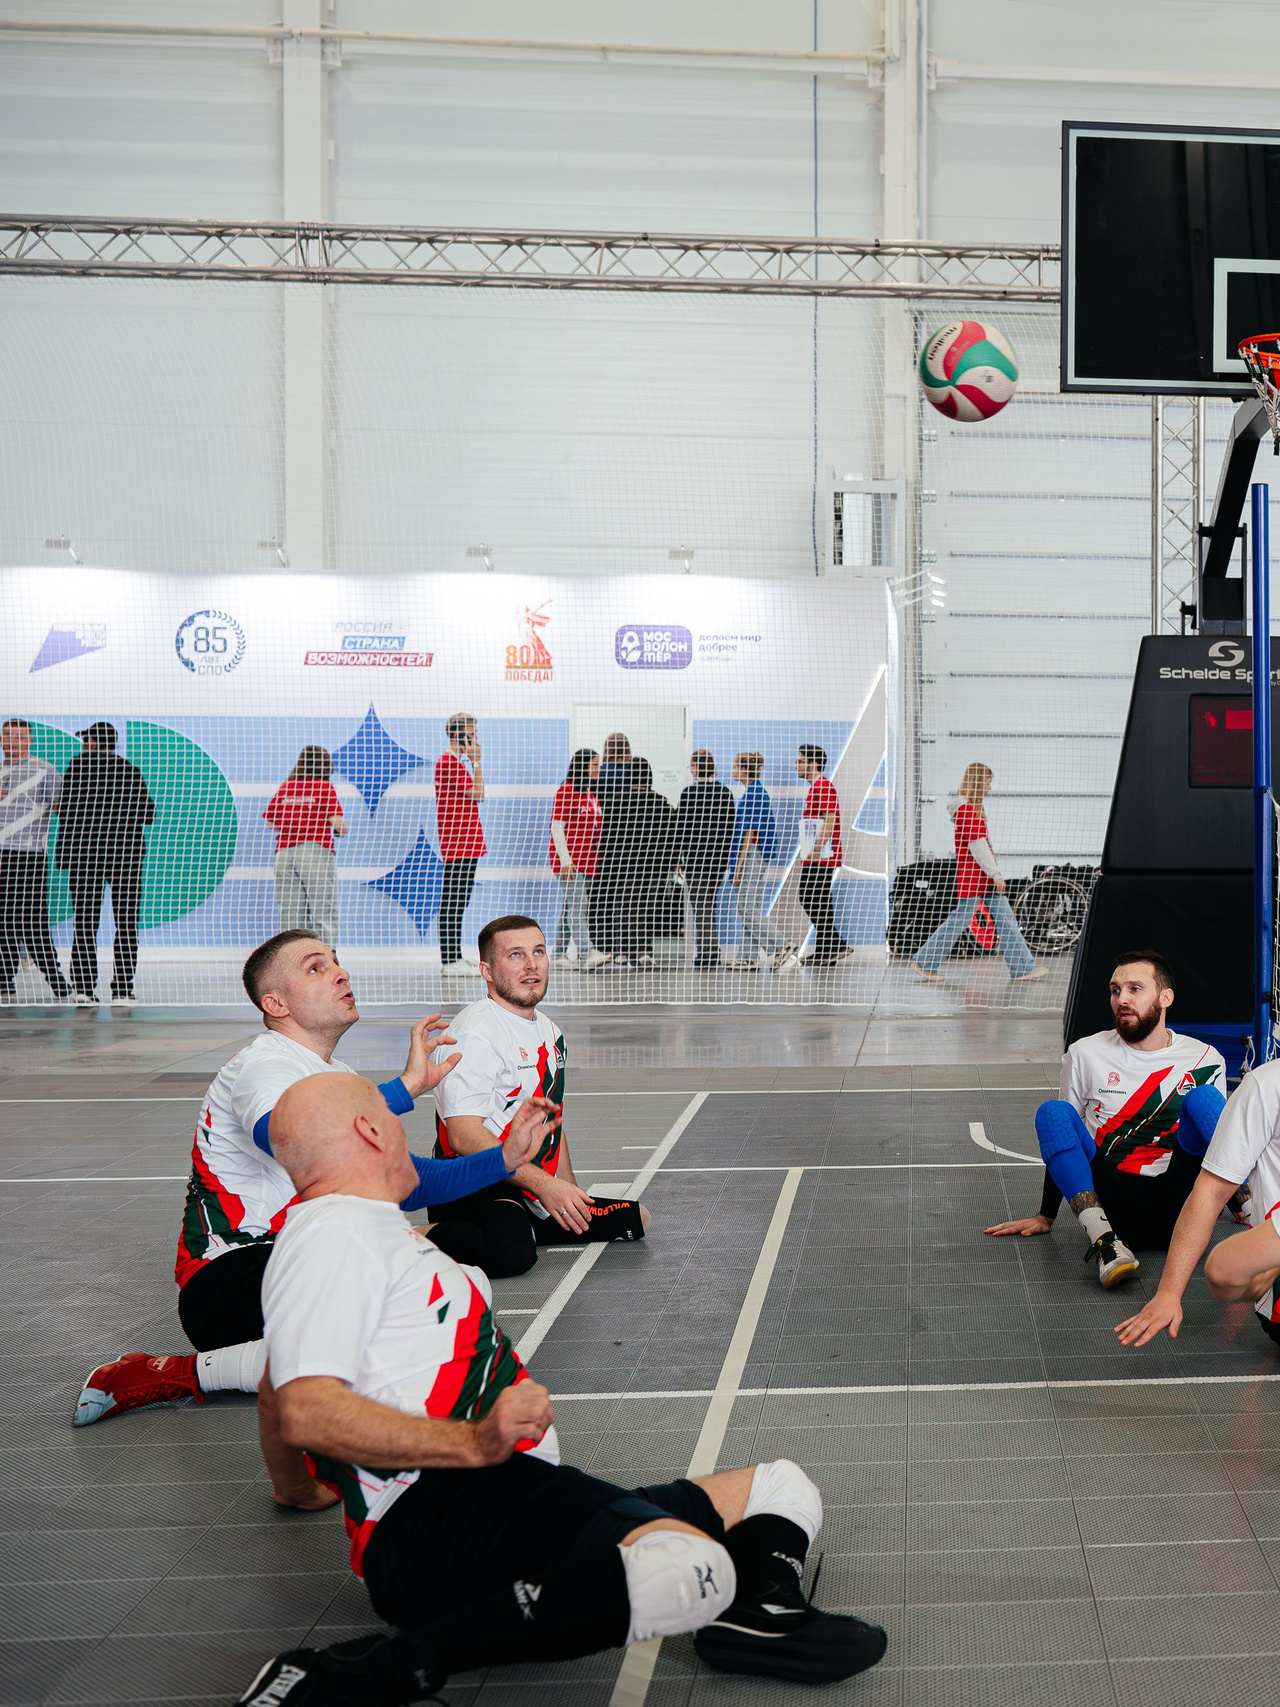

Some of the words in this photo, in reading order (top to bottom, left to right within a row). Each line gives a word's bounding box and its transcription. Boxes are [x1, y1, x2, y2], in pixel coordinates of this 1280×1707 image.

[334, 621, 393, 633] РОССИЯ
[194, 626, 228, 653] 85
[643, 631, 672, 642] МОС
[699, 634, 738, 642] делаем
[740, 634, 762, 643] мир
[344, 637, 400, 650] СТРАНА
[643, 641, 687, 652] ВОЛОН
[306, 651, 428, 667] ВОЗМОЖНОСТЕЙ
[505, 645, 531, 666] 80
[198, 665, 222, 676] СПО
[505, 670, 553, 684] ПОБЕДА!
[1159, 667, 1231, 680] Schelde
[247, 1663, 308, 1707] EVERLA
